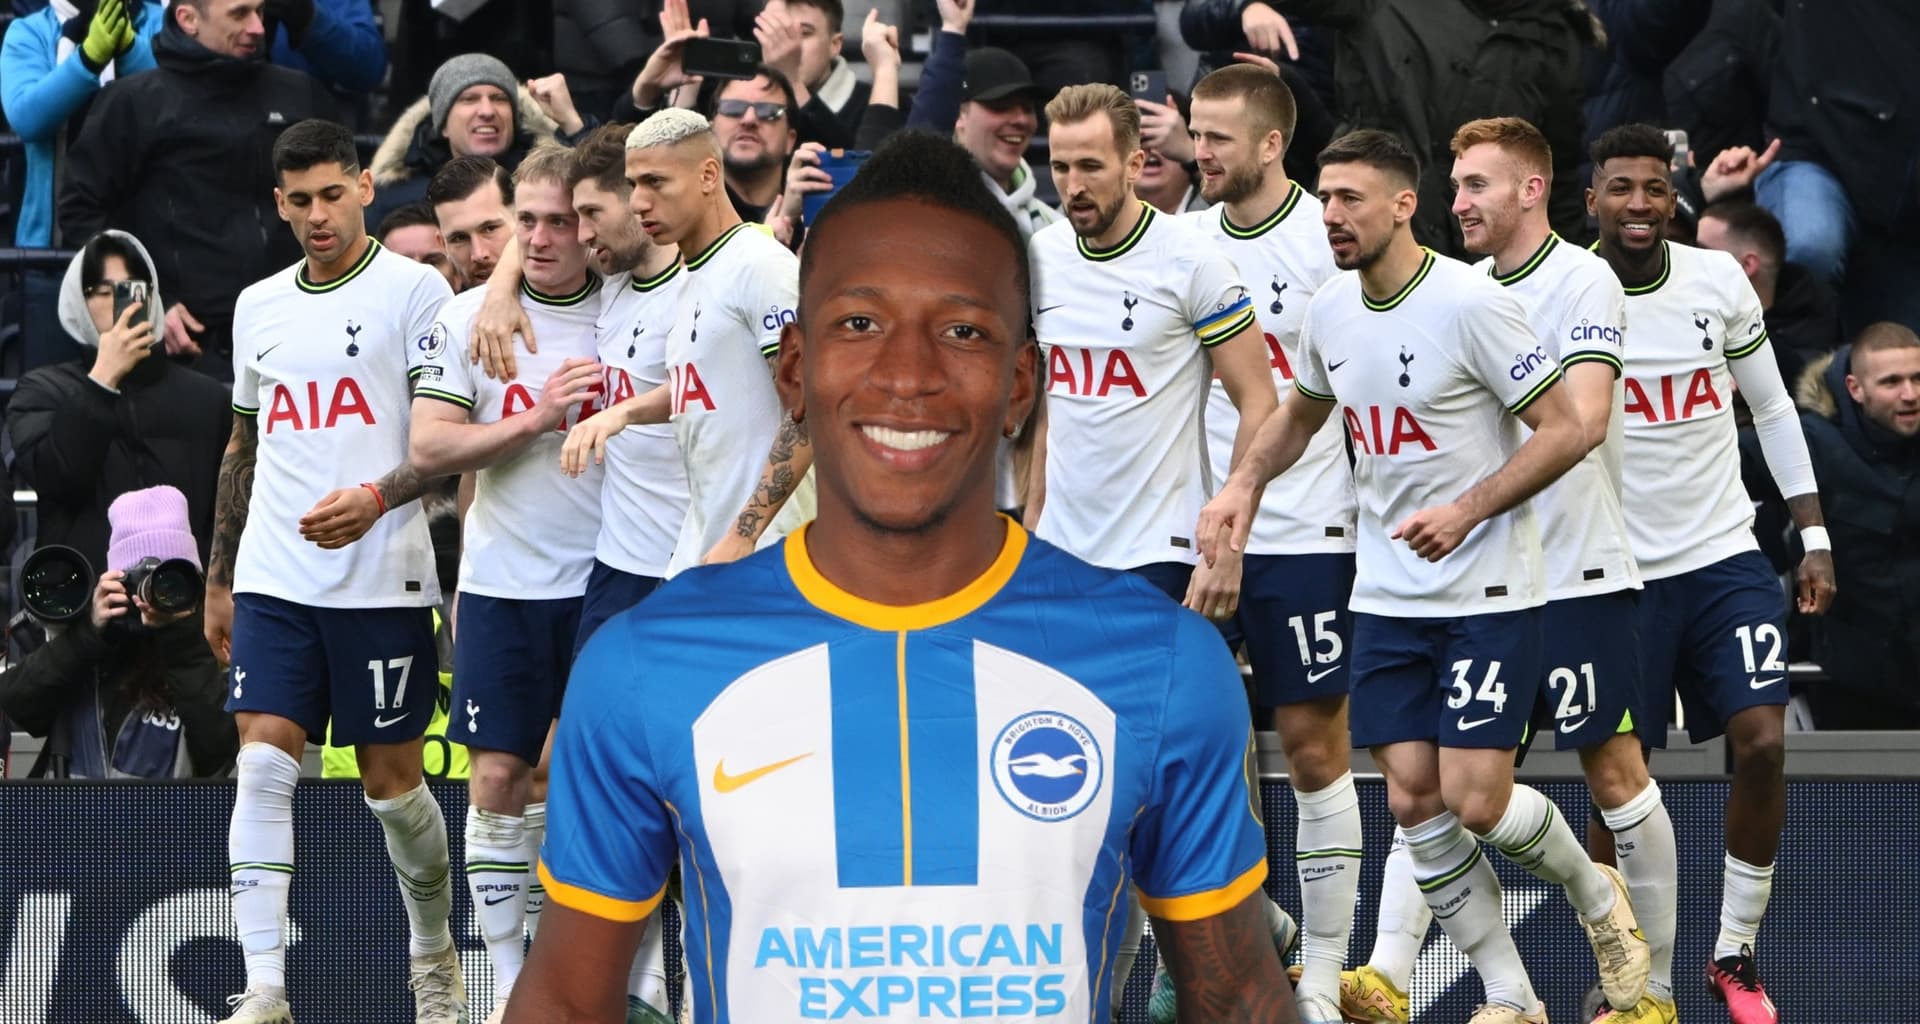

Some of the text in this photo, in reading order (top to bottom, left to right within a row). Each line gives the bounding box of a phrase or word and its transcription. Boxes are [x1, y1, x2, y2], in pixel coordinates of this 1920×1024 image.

[763, 305, 799, 330] cin
[1571, 318, 1622, 347] cinch
[666, 362, 717, 415] IA
[1047, 345, 1148, 397] AIA
[1624, 367, 1722, 423] AIA
[266, 377, 376, 434] AIA
[1343, 406, 1438, 455] AIA
[1288, 610, 1343, 666] 15
[1735, 623, 1785, 673] 12
[368, 656, 414, 709] 17
[1447, 659, 1508, 713] 34
[1549, 662, 1596, 719] 21
[1004, 717, 1091, 746] BRIGHTON & HOVE
[1027, 803, 1068, 815] ALBION
[476, 884, 521, 893] SPURS
[754, 924, 1063, 968] AMERICAN
[799, 974, 1067, 1019] EXPRESS
